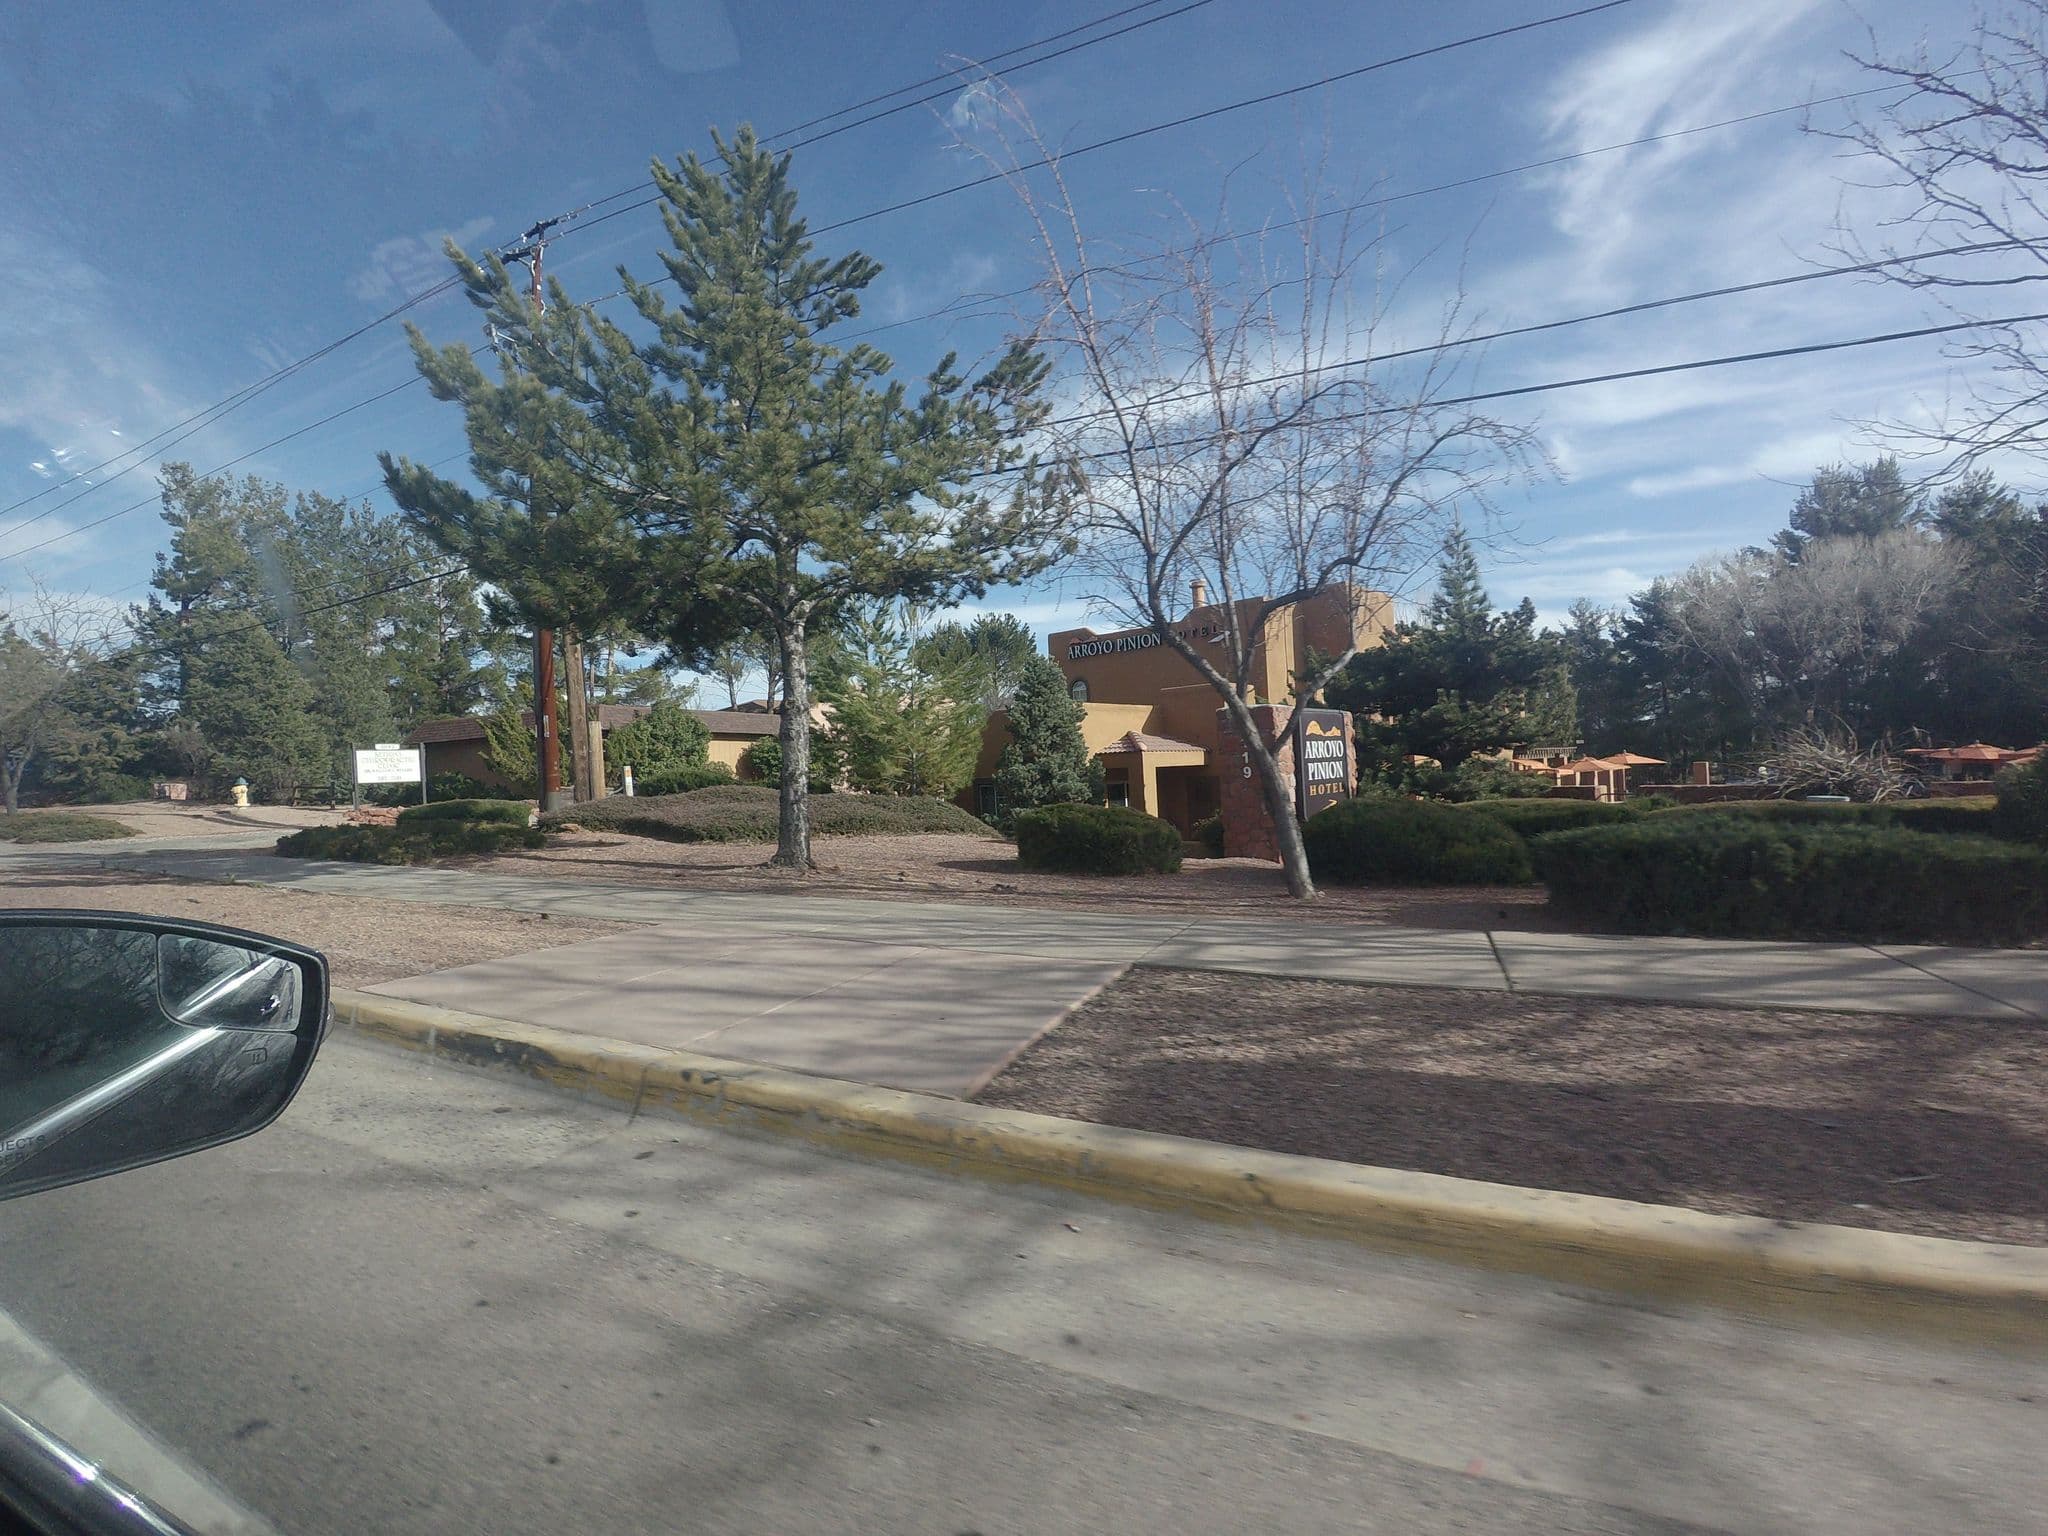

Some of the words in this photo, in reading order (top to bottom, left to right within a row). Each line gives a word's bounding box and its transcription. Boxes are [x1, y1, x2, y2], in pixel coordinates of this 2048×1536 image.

[1068, 640, 1113, 659] ARROYO
[1116, 632, 1162, 652] PINION
[1305, 740, 1343, 759] ARROYO
[1308, 761, 1344, 780] PINION
[1310, 783, 1344, 796] HOTEL
